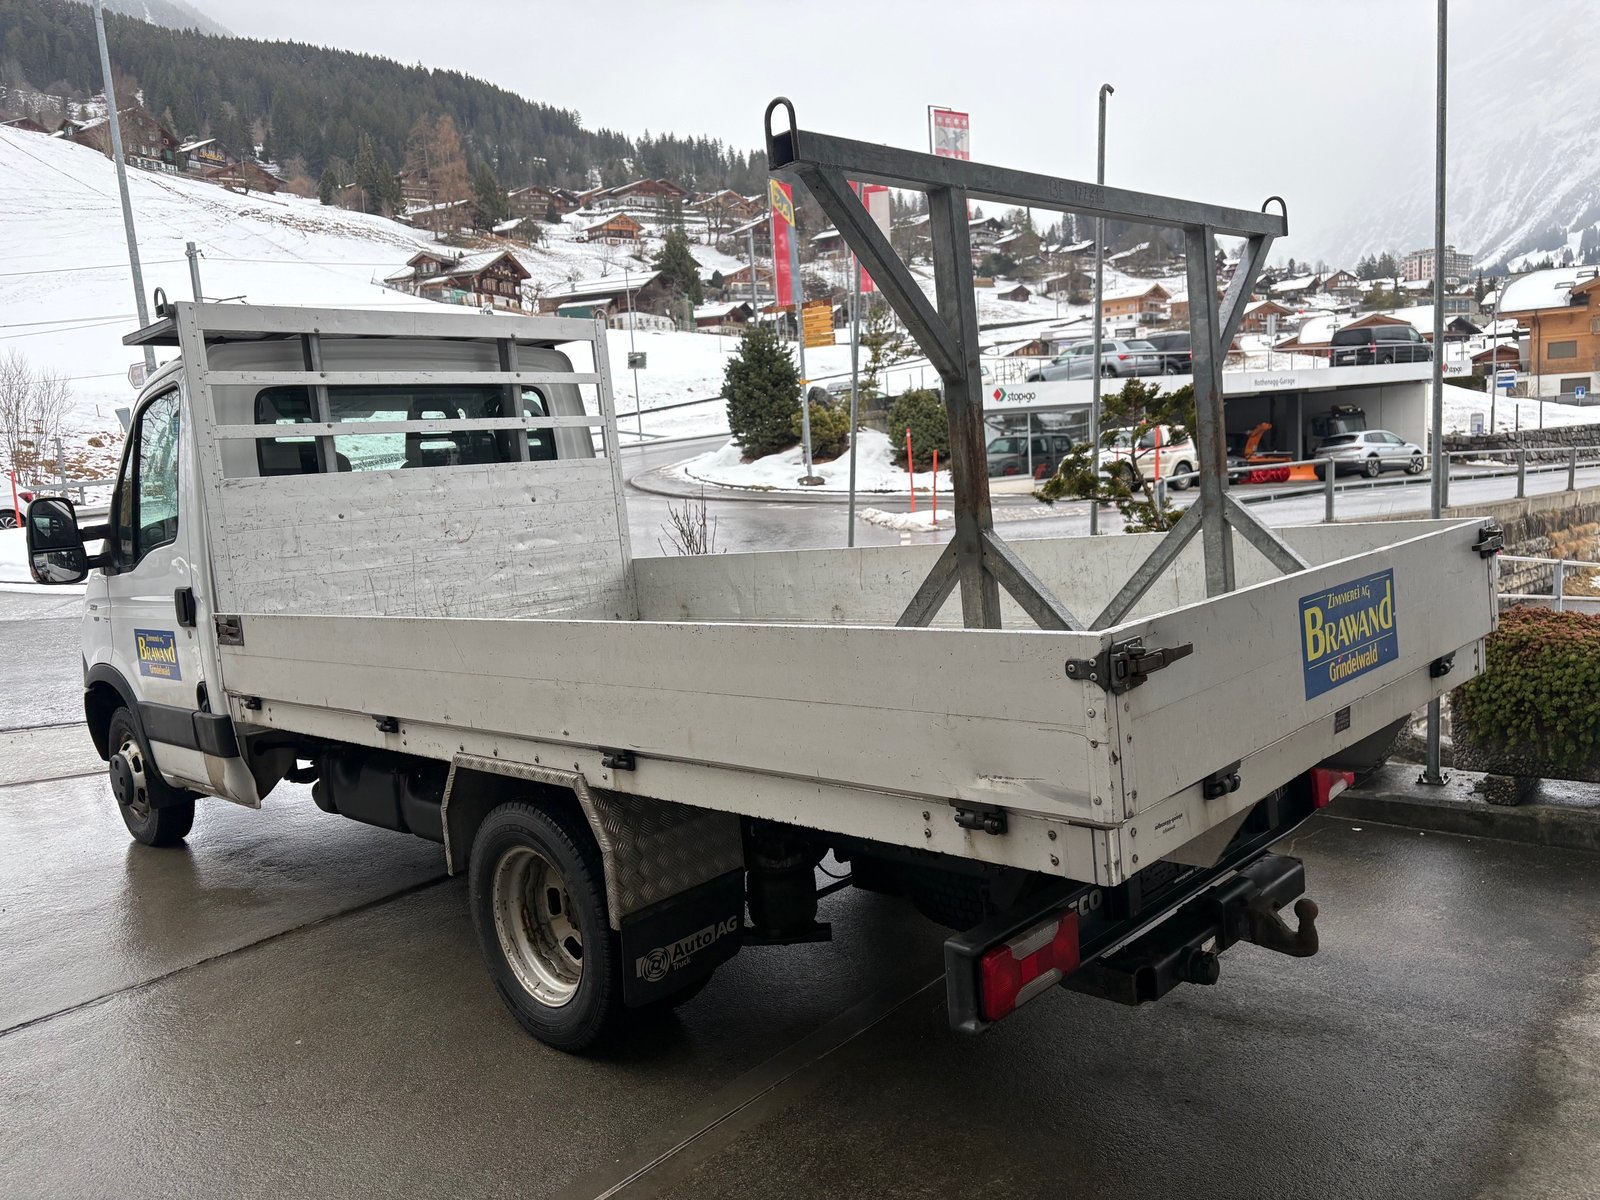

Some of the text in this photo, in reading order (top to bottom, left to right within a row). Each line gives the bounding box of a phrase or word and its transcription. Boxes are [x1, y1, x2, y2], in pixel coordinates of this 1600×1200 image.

[1007, 391, 1036, 403] stop+go
[1361, 585, 1371, 599] AG
[1329, 642, 1378, 682] Grindelwald
[672, 915, 738, 961] Auto AG
[672, 956, 691, 971] Truck
